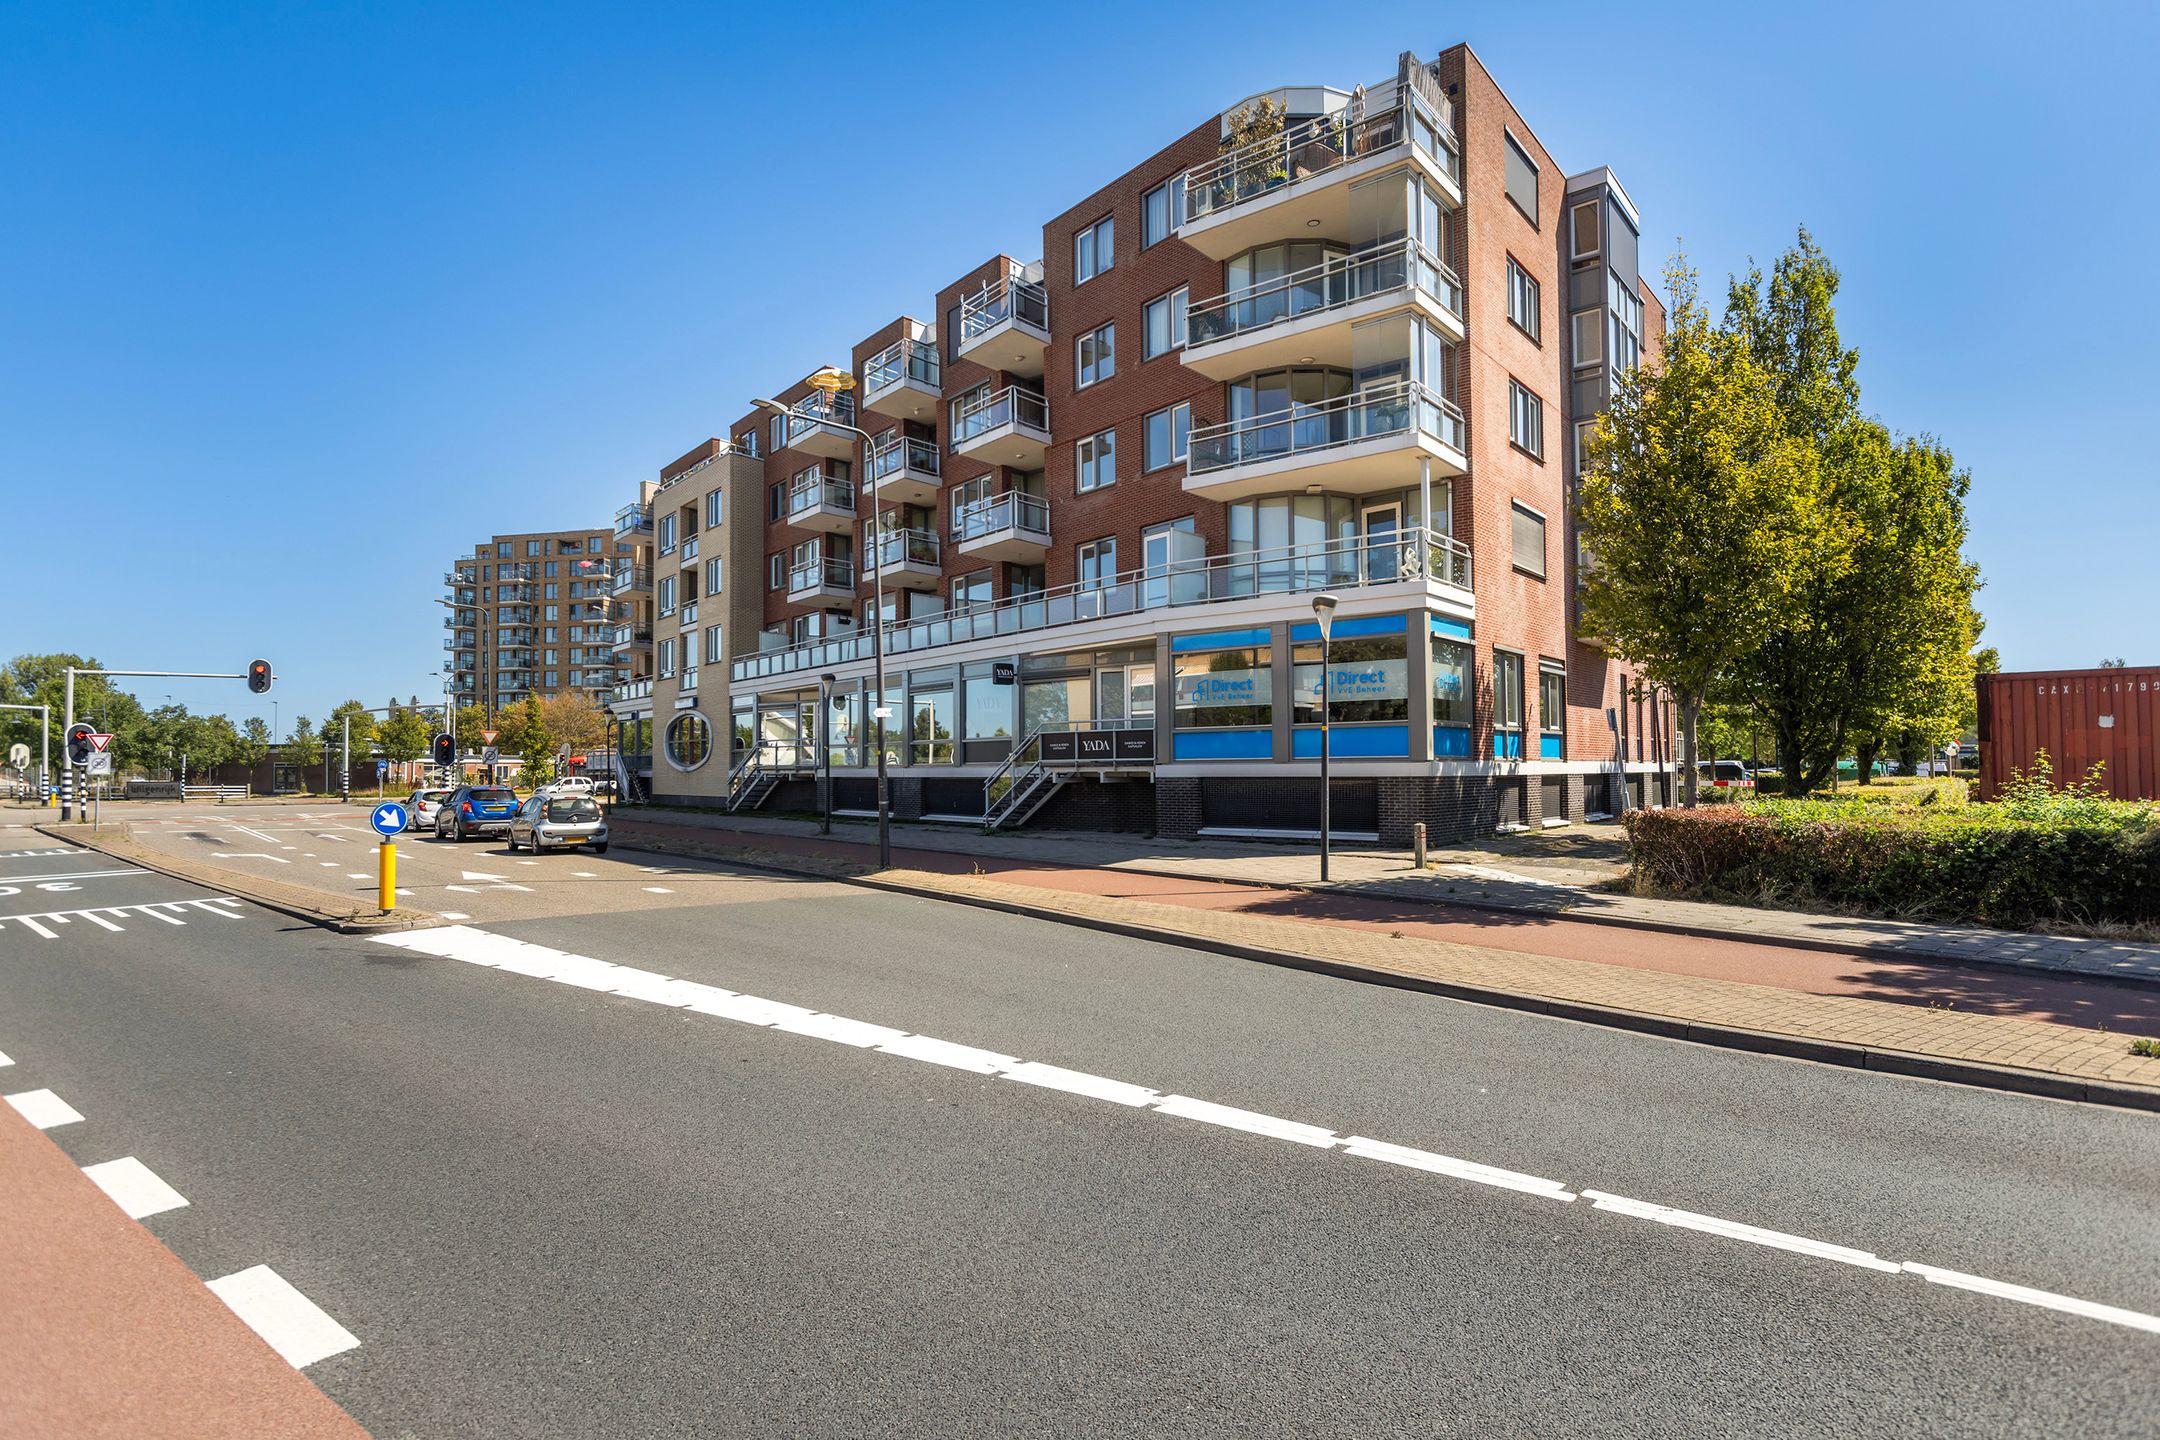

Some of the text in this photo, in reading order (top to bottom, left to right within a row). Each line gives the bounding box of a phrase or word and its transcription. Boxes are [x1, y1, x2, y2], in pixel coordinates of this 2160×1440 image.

[1336, 670, 1385, 685] Direct
[1211, 678, 1254, 692] Direct
[1356, 685, 1386, 694] Beheer
[1082, 740, 1110, 751] YADA
[130, 784, 176, 796] Wilgenrijk
